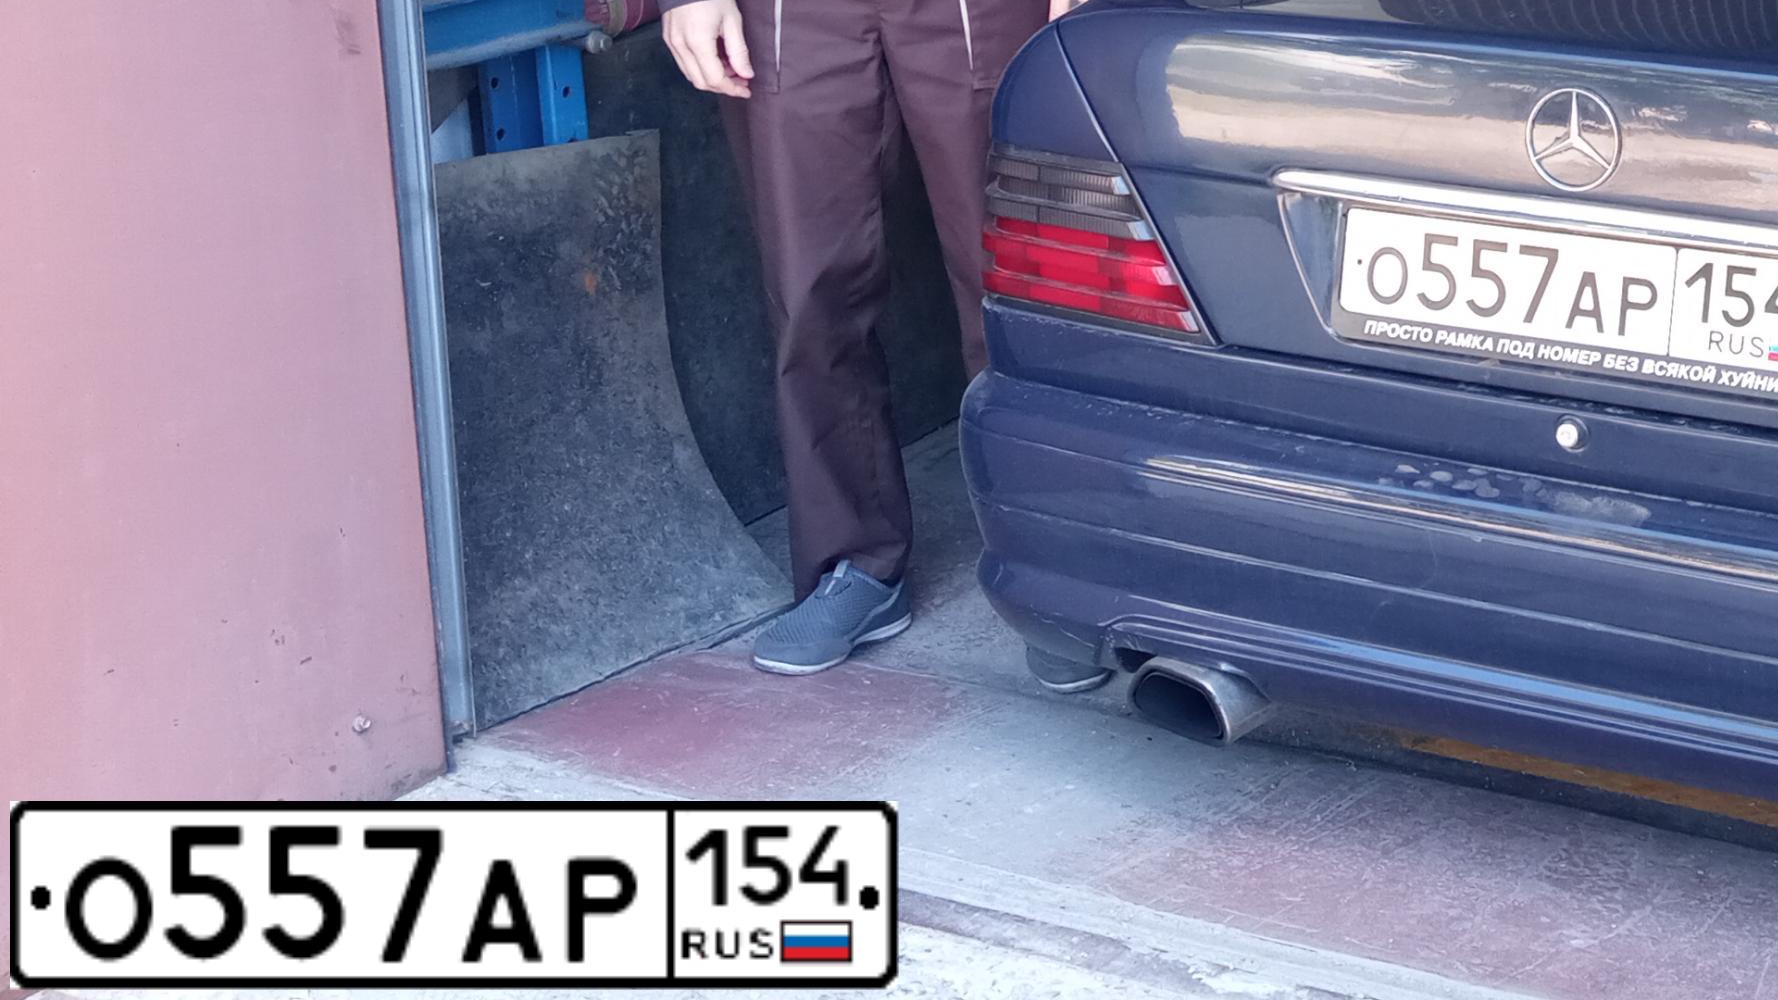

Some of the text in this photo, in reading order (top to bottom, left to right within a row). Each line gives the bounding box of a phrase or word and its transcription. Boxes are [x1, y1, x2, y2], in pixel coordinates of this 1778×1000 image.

[1364, 319, 1433, 343] ПРОСТО
[1435, 329, 1494, 352] РАМКА
[1496, 338, 1535, 360] ПОД
[1537, 345, 1602, 367] НОМЕР
[1602, 352, 1640, 372] БЕЗ
[1641, 358, 1717, 385] ВСЯКОЙ
[1708, 330, 1764, 358] RUS
